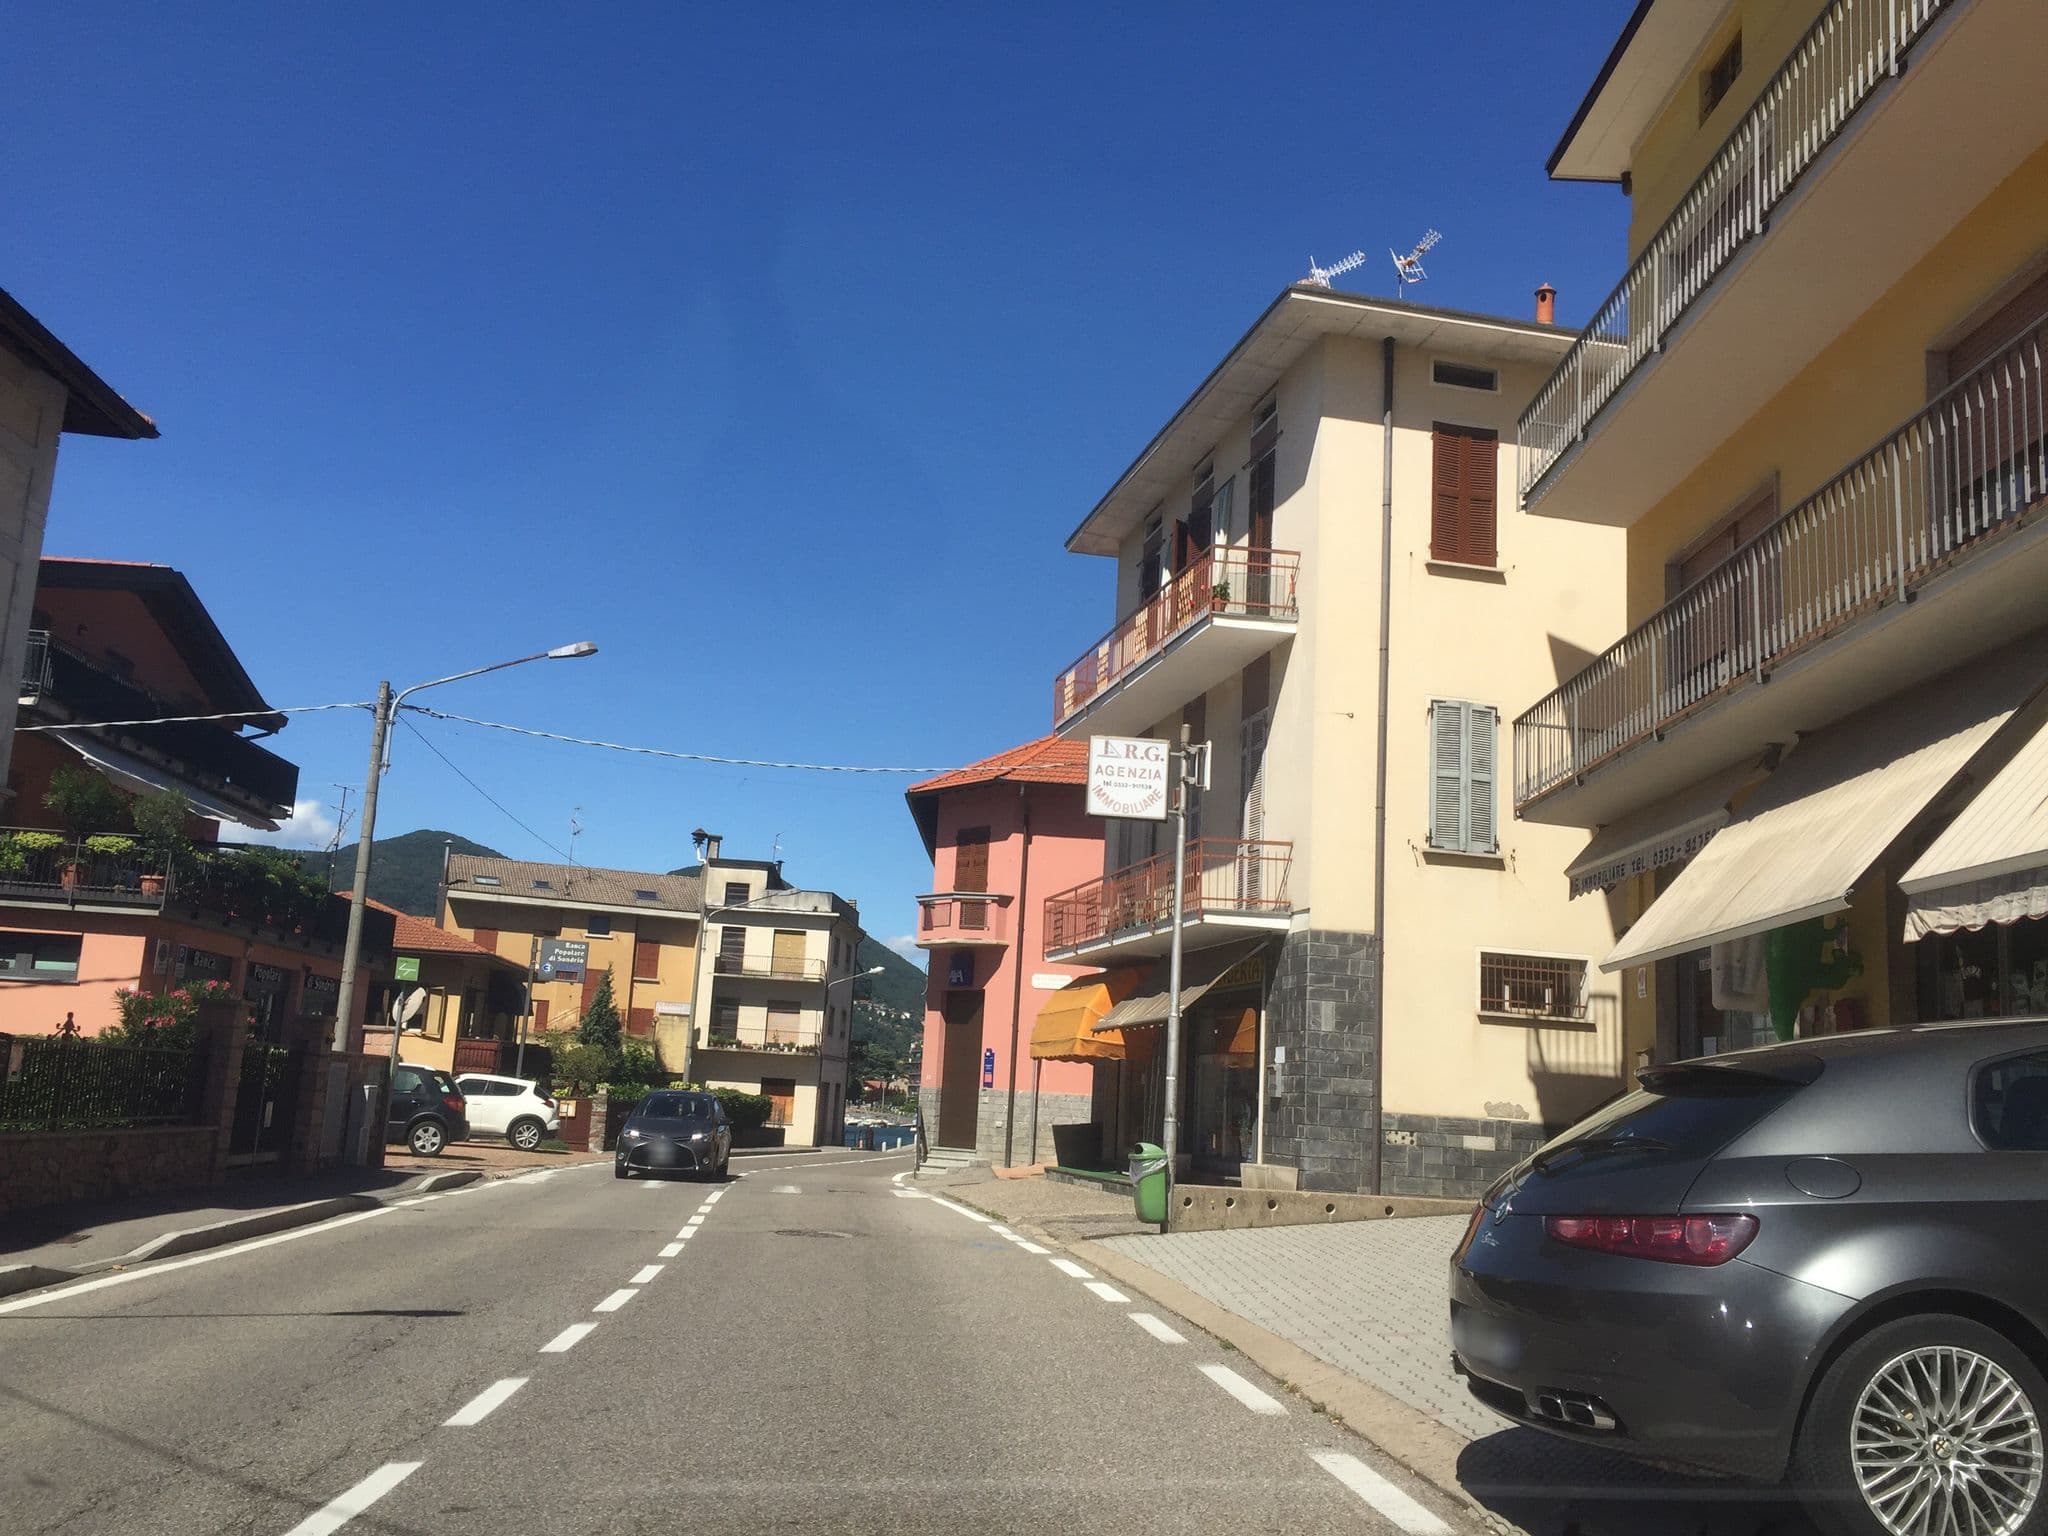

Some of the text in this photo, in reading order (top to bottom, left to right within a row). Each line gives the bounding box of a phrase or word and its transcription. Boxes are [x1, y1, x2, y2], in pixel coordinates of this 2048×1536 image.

[1095, 764, 1162, 780] AGENZIA
[1092, 785, 1163, 813] IMMOBILIARE
[1581, 863, 1626, 890] IMMOBILIARE
[193, 950, 216, 969] Banca
[554, 948, 584, 956] Popolare
